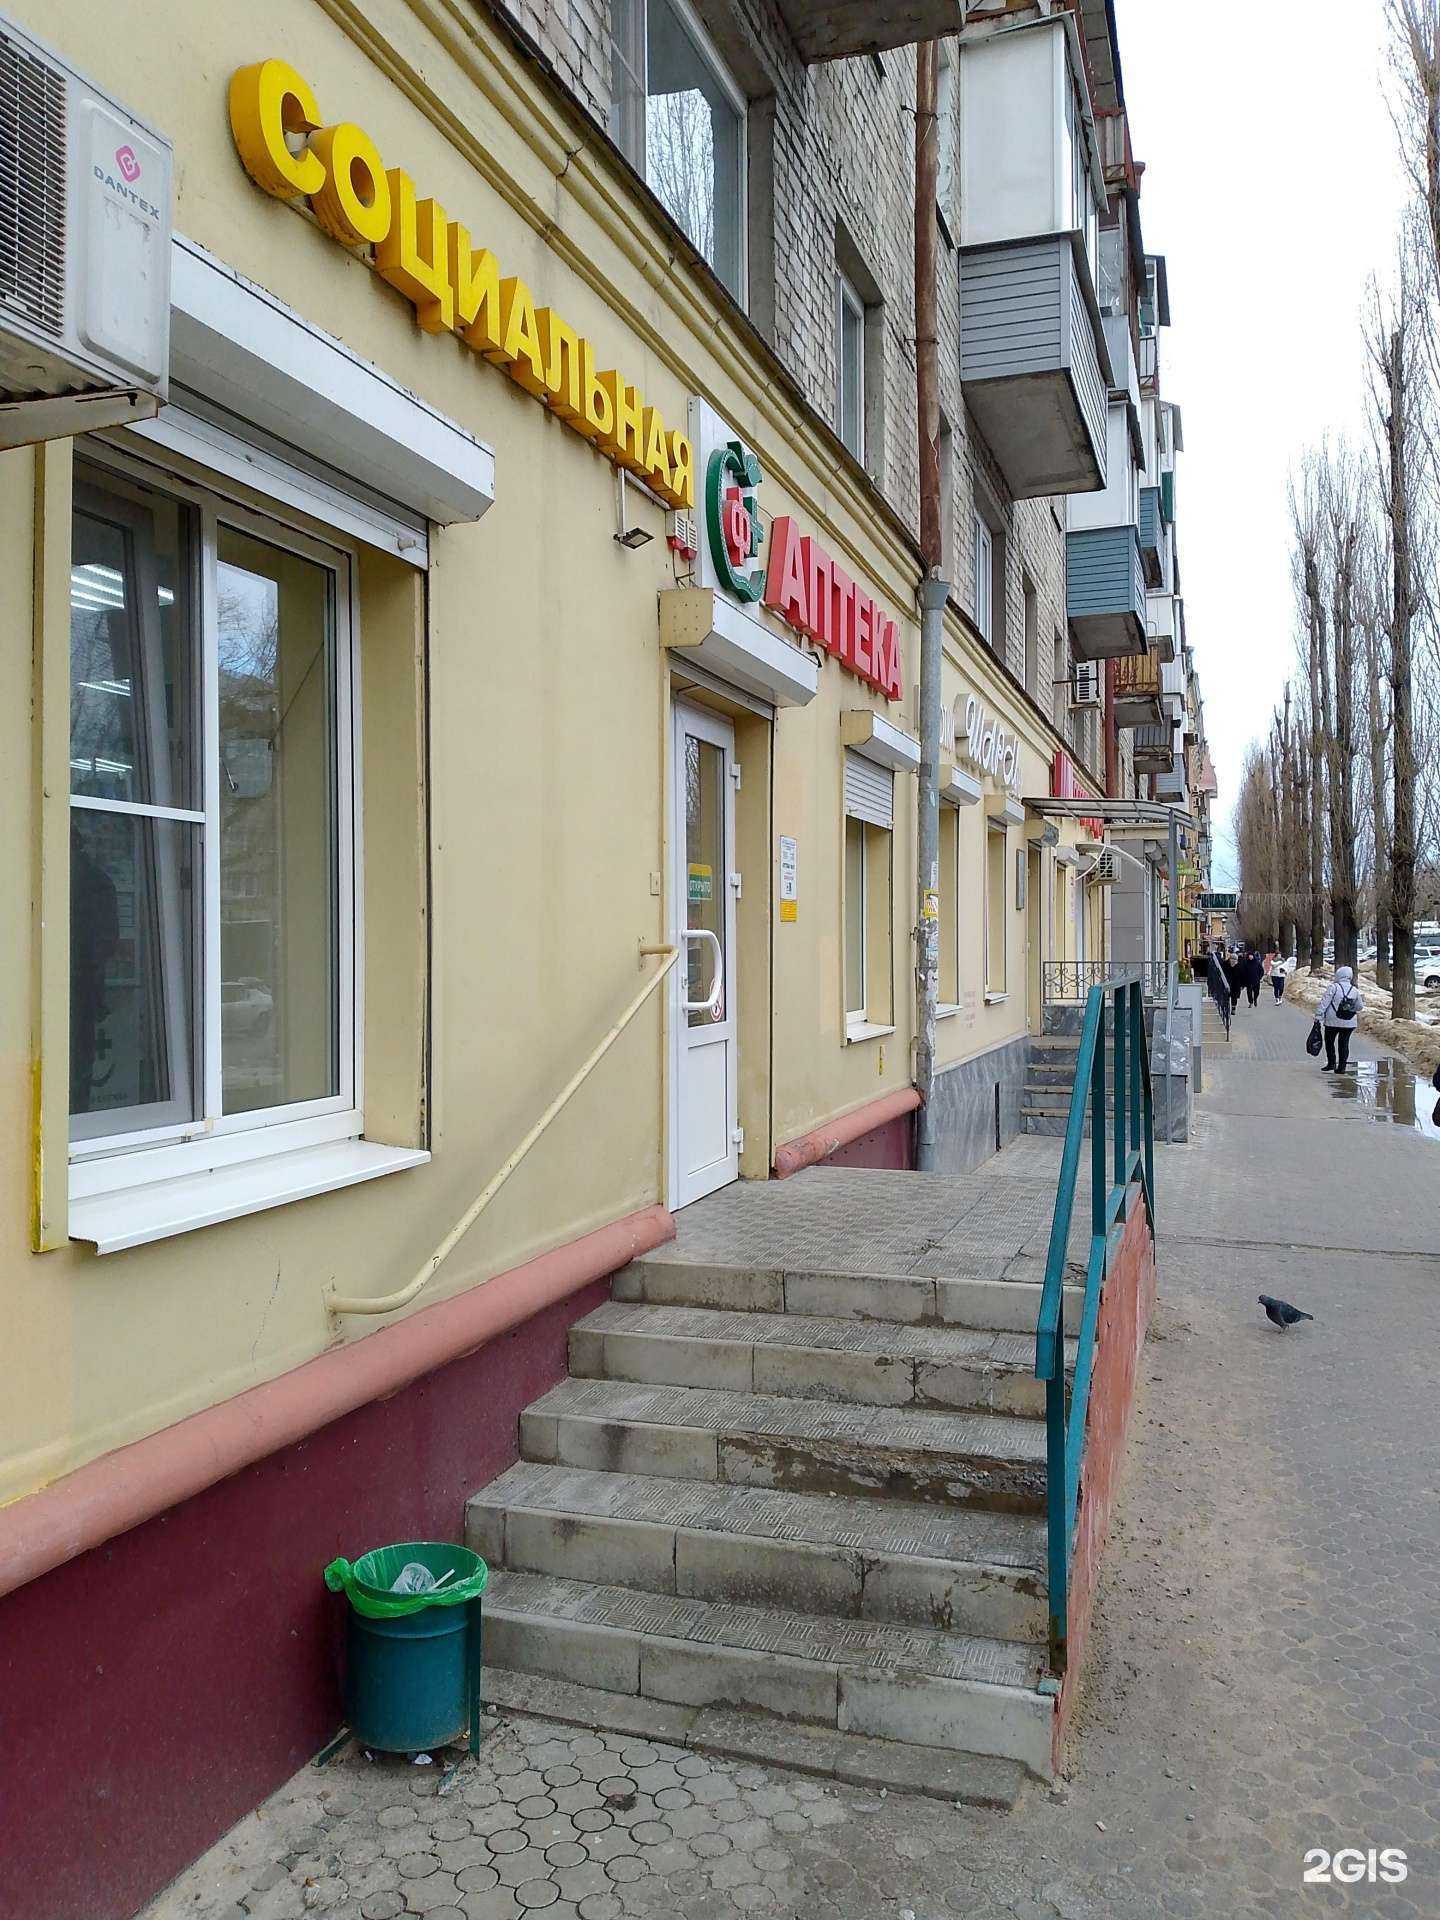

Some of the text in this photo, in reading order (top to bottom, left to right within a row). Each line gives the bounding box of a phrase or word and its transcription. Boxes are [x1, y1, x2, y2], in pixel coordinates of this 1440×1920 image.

[93, 165, 160, 220] DANTEX
[228, 58, 903, 701] СОЦИАЛЬНАЯ АПТЕКА
